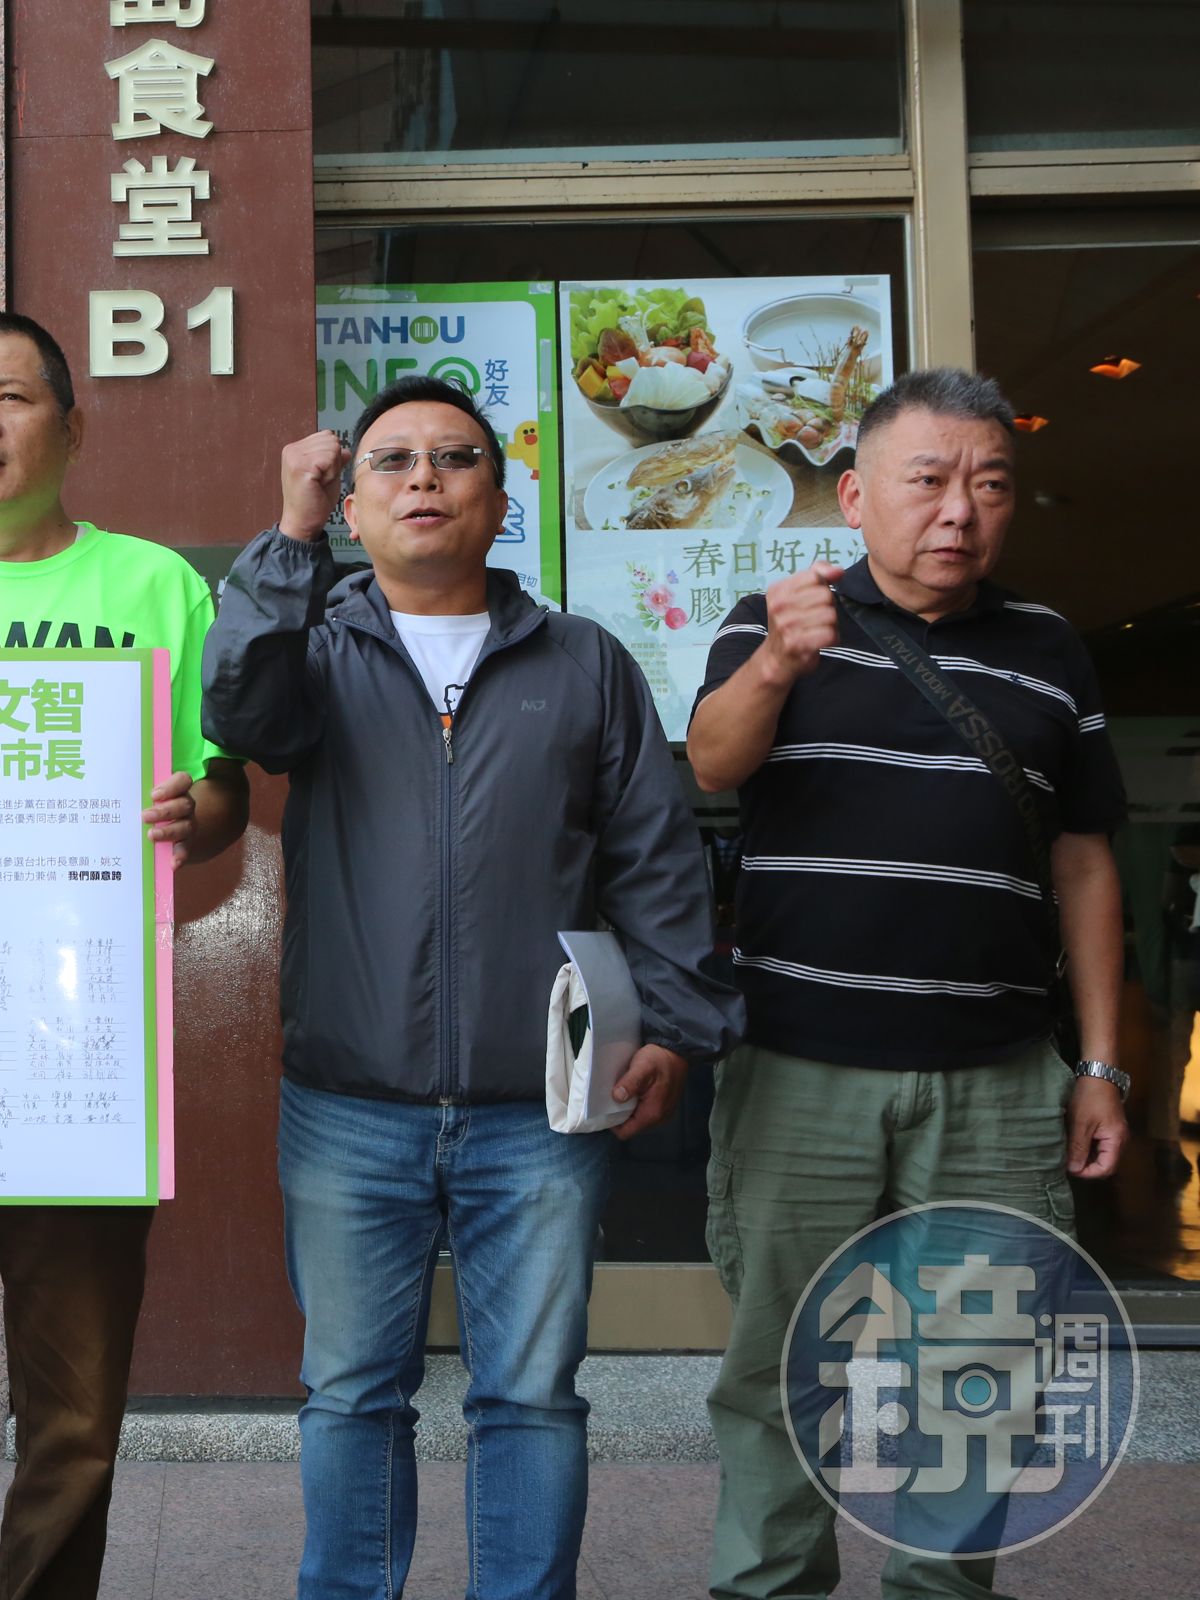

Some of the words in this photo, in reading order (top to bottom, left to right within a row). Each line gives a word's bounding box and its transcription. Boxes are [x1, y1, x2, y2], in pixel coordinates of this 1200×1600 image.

[104, 0, 214, 257] 食堂
[89, 286, 234, 377] B1
[318, 315, 465, 345] TANHOU
[484, 358, 510, 407] 好友
